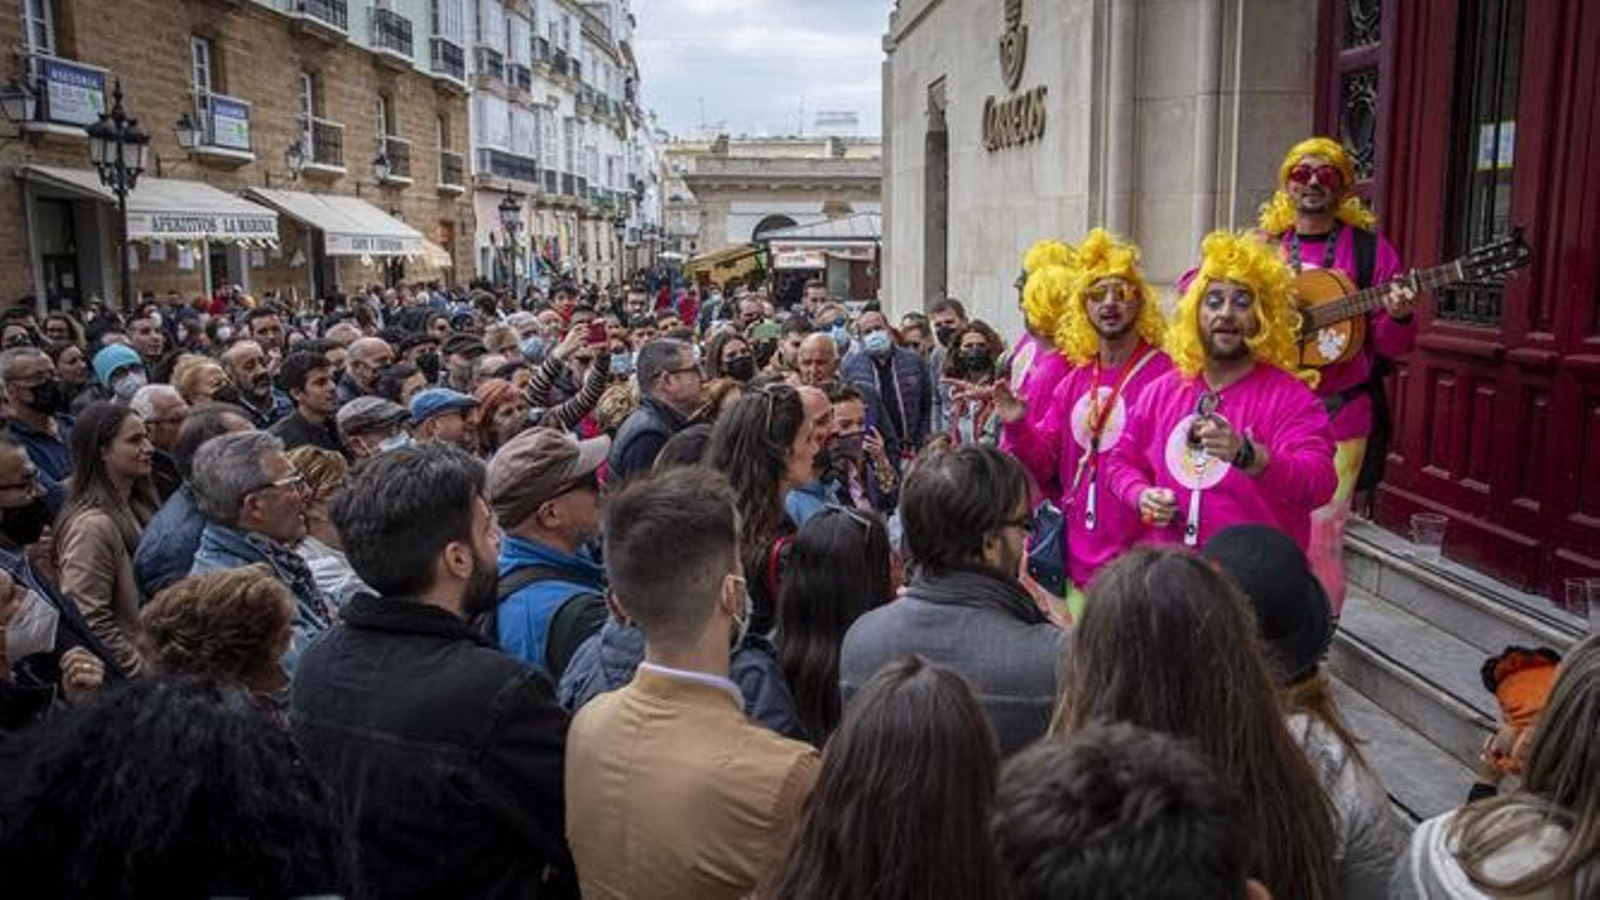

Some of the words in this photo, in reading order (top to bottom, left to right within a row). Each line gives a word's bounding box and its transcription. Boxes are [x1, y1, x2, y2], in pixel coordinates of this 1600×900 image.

[982, 85, 1048, 152] CORREOS
[152, 216, 217, 233] APERITIVOS
[237, 218, 274, 233] MARINA
